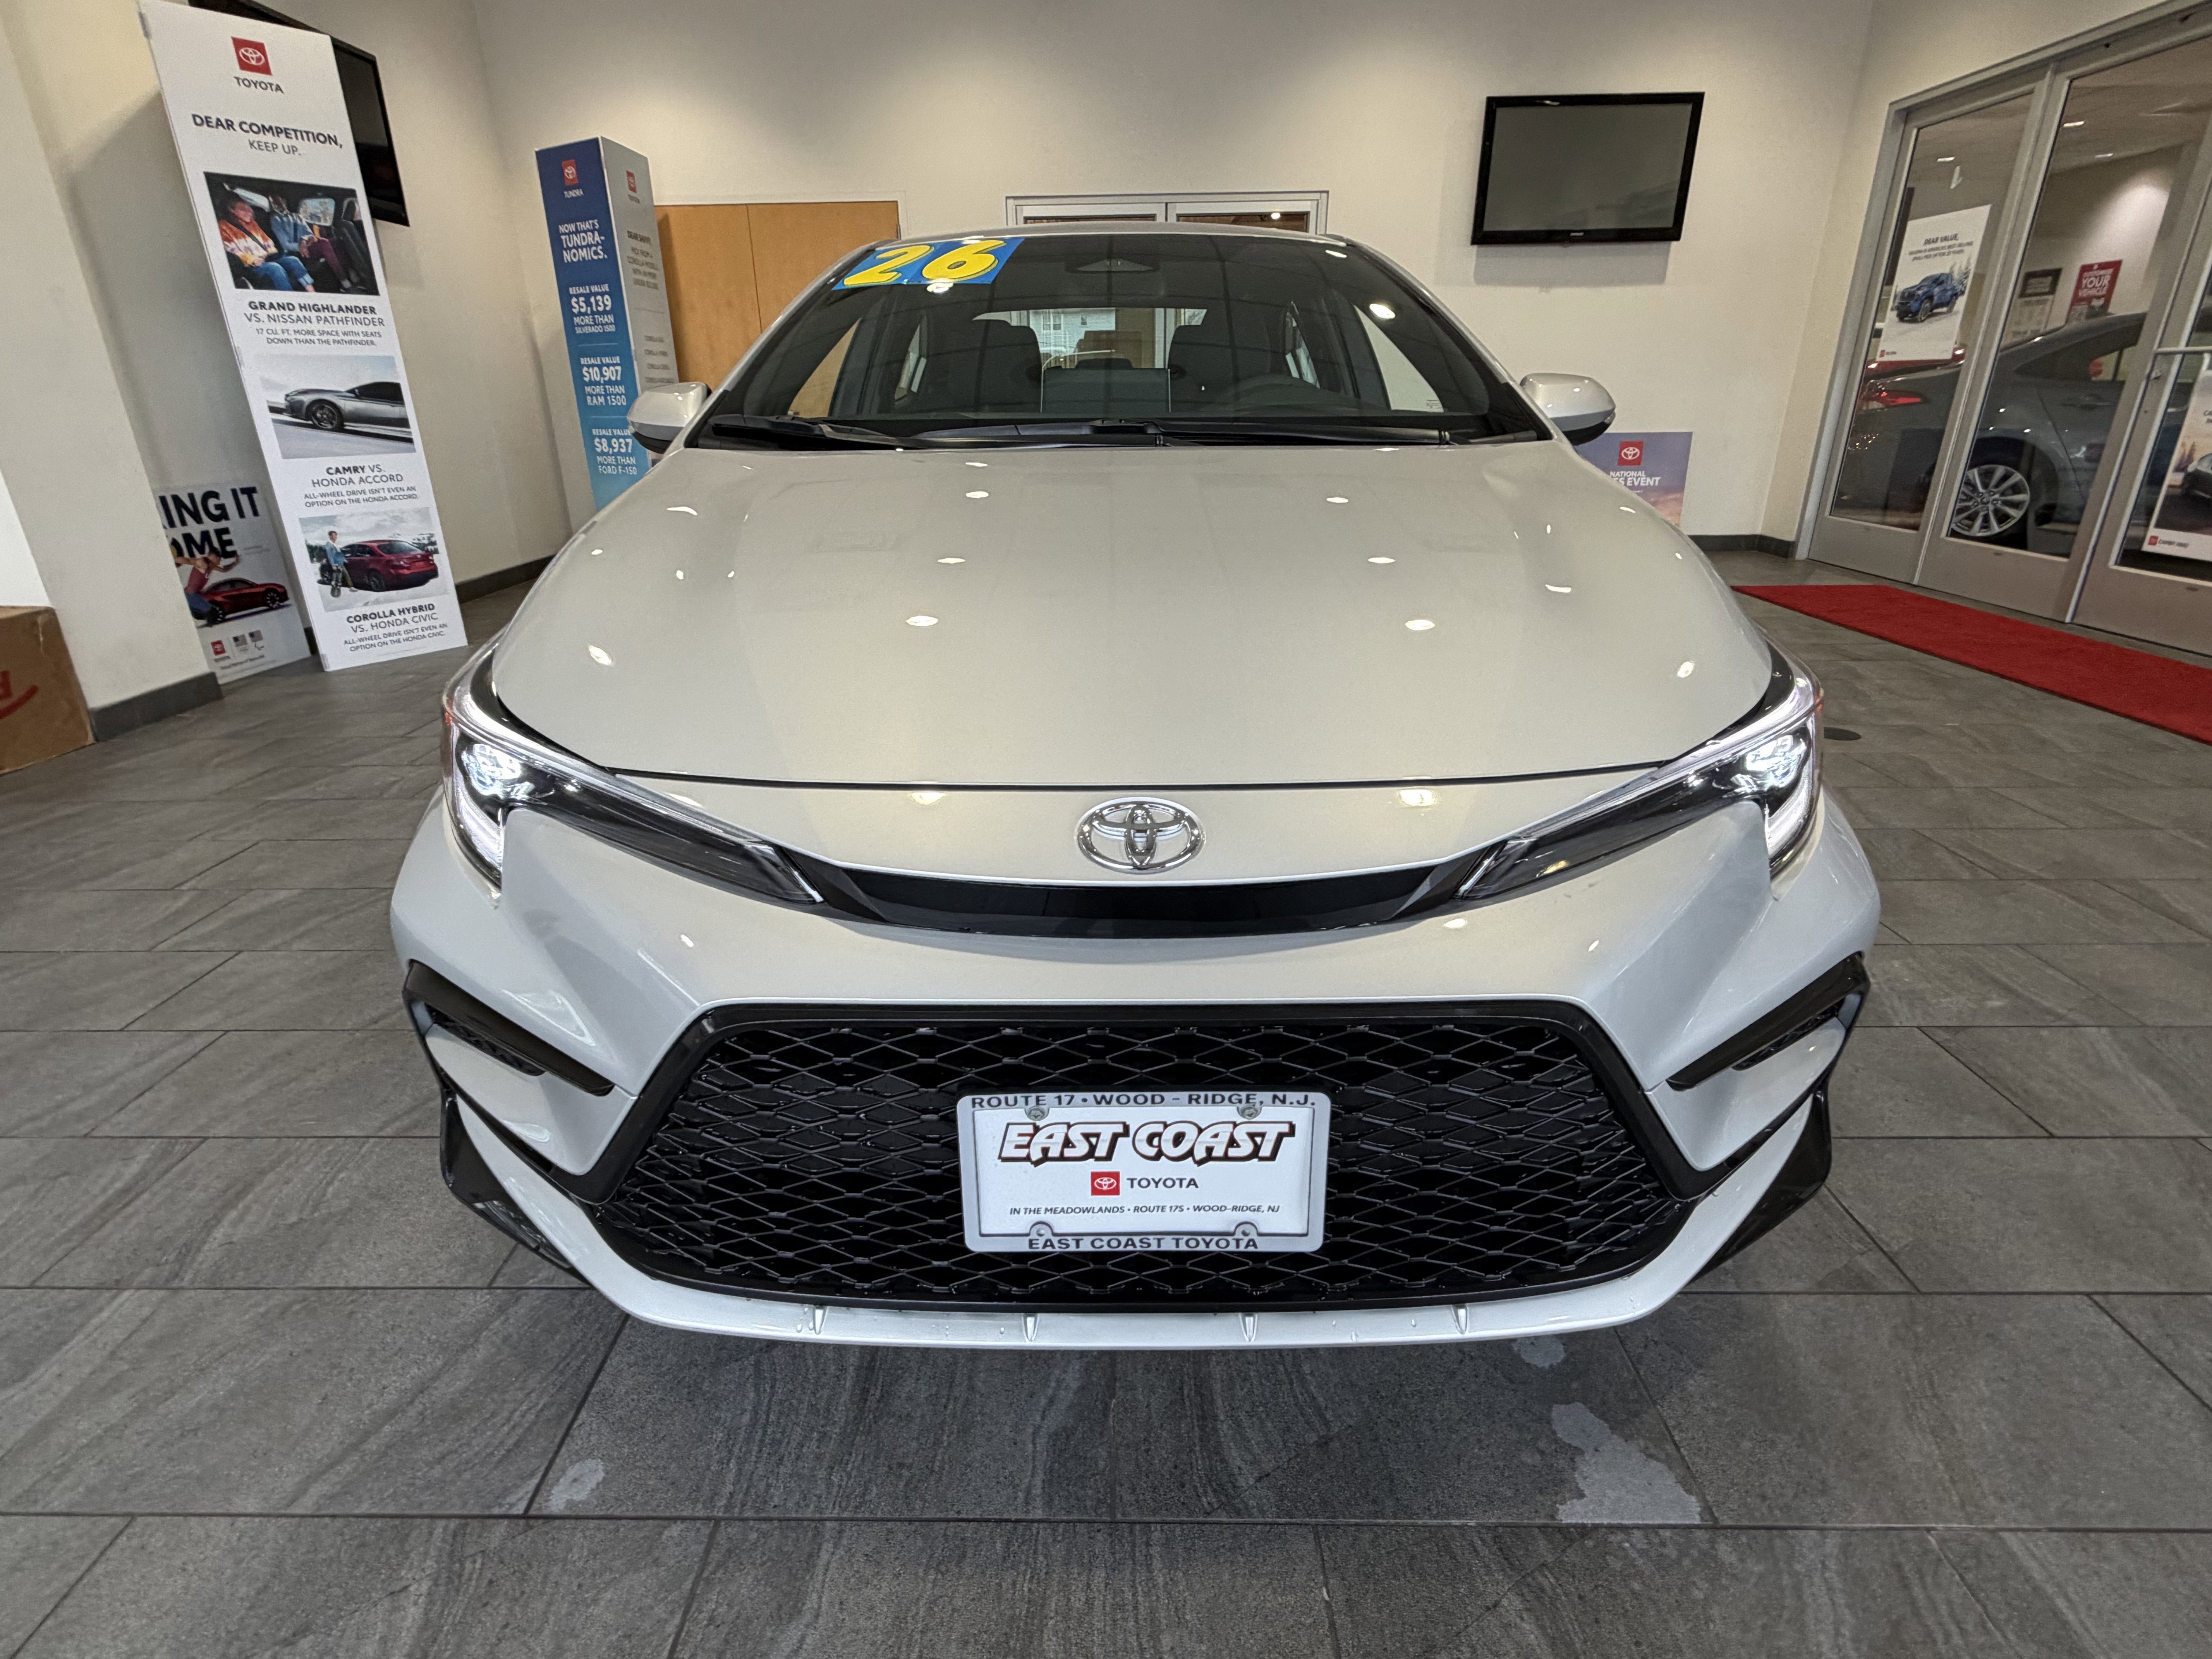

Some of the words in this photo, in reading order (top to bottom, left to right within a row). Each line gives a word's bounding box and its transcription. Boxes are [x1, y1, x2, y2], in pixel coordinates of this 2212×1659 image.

[234, 76, 284, 94] TOYOTA
[192, 113, 237, 132] DEAR
[239, 121, 342, 148] COMPETITION,
[248, 139, 278, 152] KEEP
[282, 144, 301, 156] UP.
[559, 223, 575, 234] NOW
[576, 219, 599, 231] THAT'S
[561, 231, 605, 248] TUNDRA-
[563, 246, 608, 263] NOMICS.
[843, 239, 1006, 287] 26
[569, 285, 590, 294] RESALE
[591, 283, 610, 292] VALUE
[2082, 275, 2111, 288] YOUR
[248, 301, 295, 311] GRAND
[298, 303, 377, 314] HIGHLANDER
[571, 294, 611, 314] $5,139
[244, 313, 264, 323] VS.
[267, 314, 312, 324] NISSAN
[316, 316, 385, 326] PATHFINDER
[574, 315, 594, 325] MORE
[594, 314, 614, 324] THAN
[575, 325, 603, 333] SILVERADO
[582, 366, 622, 383] $10,907
[585, 385, 605, 395] MORE
[605, 385, 625, 394] THAN
[587, 395, 605, 405] RAM
[607, 395, 626, 405] 1500
[594, 436, 632, 454] $8,937
[596, 456, 617, 465] MORE
[617, 456, 635, 464] THAN
[326, 465, 365, 475] CAMRY
[368, 464, 386, 472] VS.
[598, 465, 617, 474] FORD
[618, 466, 637, 475] F-150
[311, 477, 356, 488] HONDA
[359, 474, 403, 484] ACCORD
[1627, 477, 1661, 486] EVENT
[304, 491, 345, 500] ALL-WHEEL
[158, 490, 230, 529] ING
[230, 486, 260, 519] IT
[346, 610, 396, 623] COROLLA
[398, 603, 435, 616] HYBRID
[351, 624, 368, 633] VS.
[370, 618, 410, 630] HONDA
[412, 613, 438, 623] CIVIC
[344, 634, 381, 645] ALL-WHEEL
[383, 630, 402, 639] DRIVE
[350, 644, 376, 652] OPTION
[403, 634, 426, 642] HONDA
[972, 1095, 1047, 1108] ROUTE
[1054, 1094, 1075, 1106] 17
[1093, 1094, 1164, 1105] WOOD
[1188, 1094, 1263, 1106] RIDGE,
[1272, 1094, 1316, 1105] N.J.
[998, 1121, 1130, 1168] EAST
[1132, 1121, 1295, 1167] COAST
[1127, 1177, 1199, 1188] TOYOTA
[1044, 1206, 1125, 1214] MEADOWLANDS
[1193, 1205, 1265, 1213] WOOD-RIDGE,
[1028, 1238, 1084, 1250] EAST
[1090, 1237, 1165, 1249] COAST
[1171, 1238, 1258, 1249] TOYOTA
